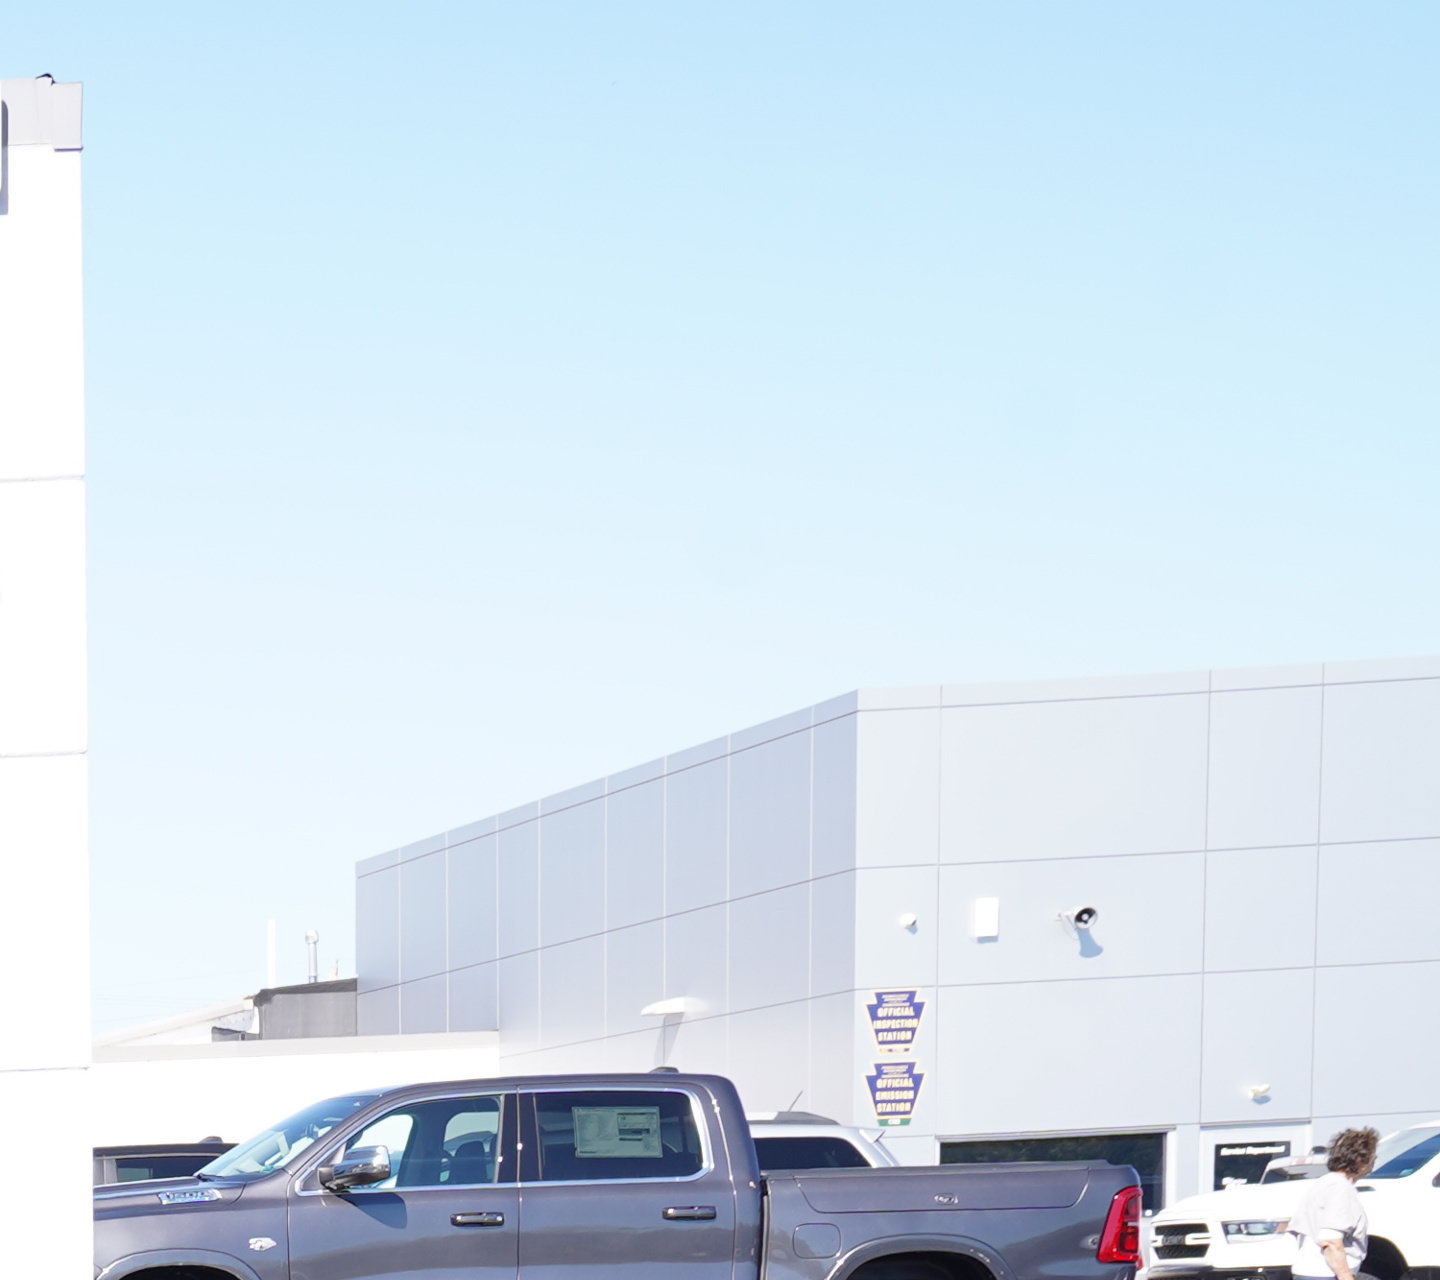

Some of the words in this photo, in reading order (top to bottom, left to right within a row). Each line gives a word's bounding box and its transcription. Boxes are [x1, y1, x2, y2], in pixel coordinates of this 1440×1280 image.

[877, 1007, 915, 1017] OFFICIAL
[873, 1019, 919, 1029] INSPECTION
[878, 1031, 912, 1041] STATION
[876, 1078, 914, 1088] OFFICIAL
[875, 1091, 915, 1101] EMISSION
[877, 1103, 911, 1113] STATION
